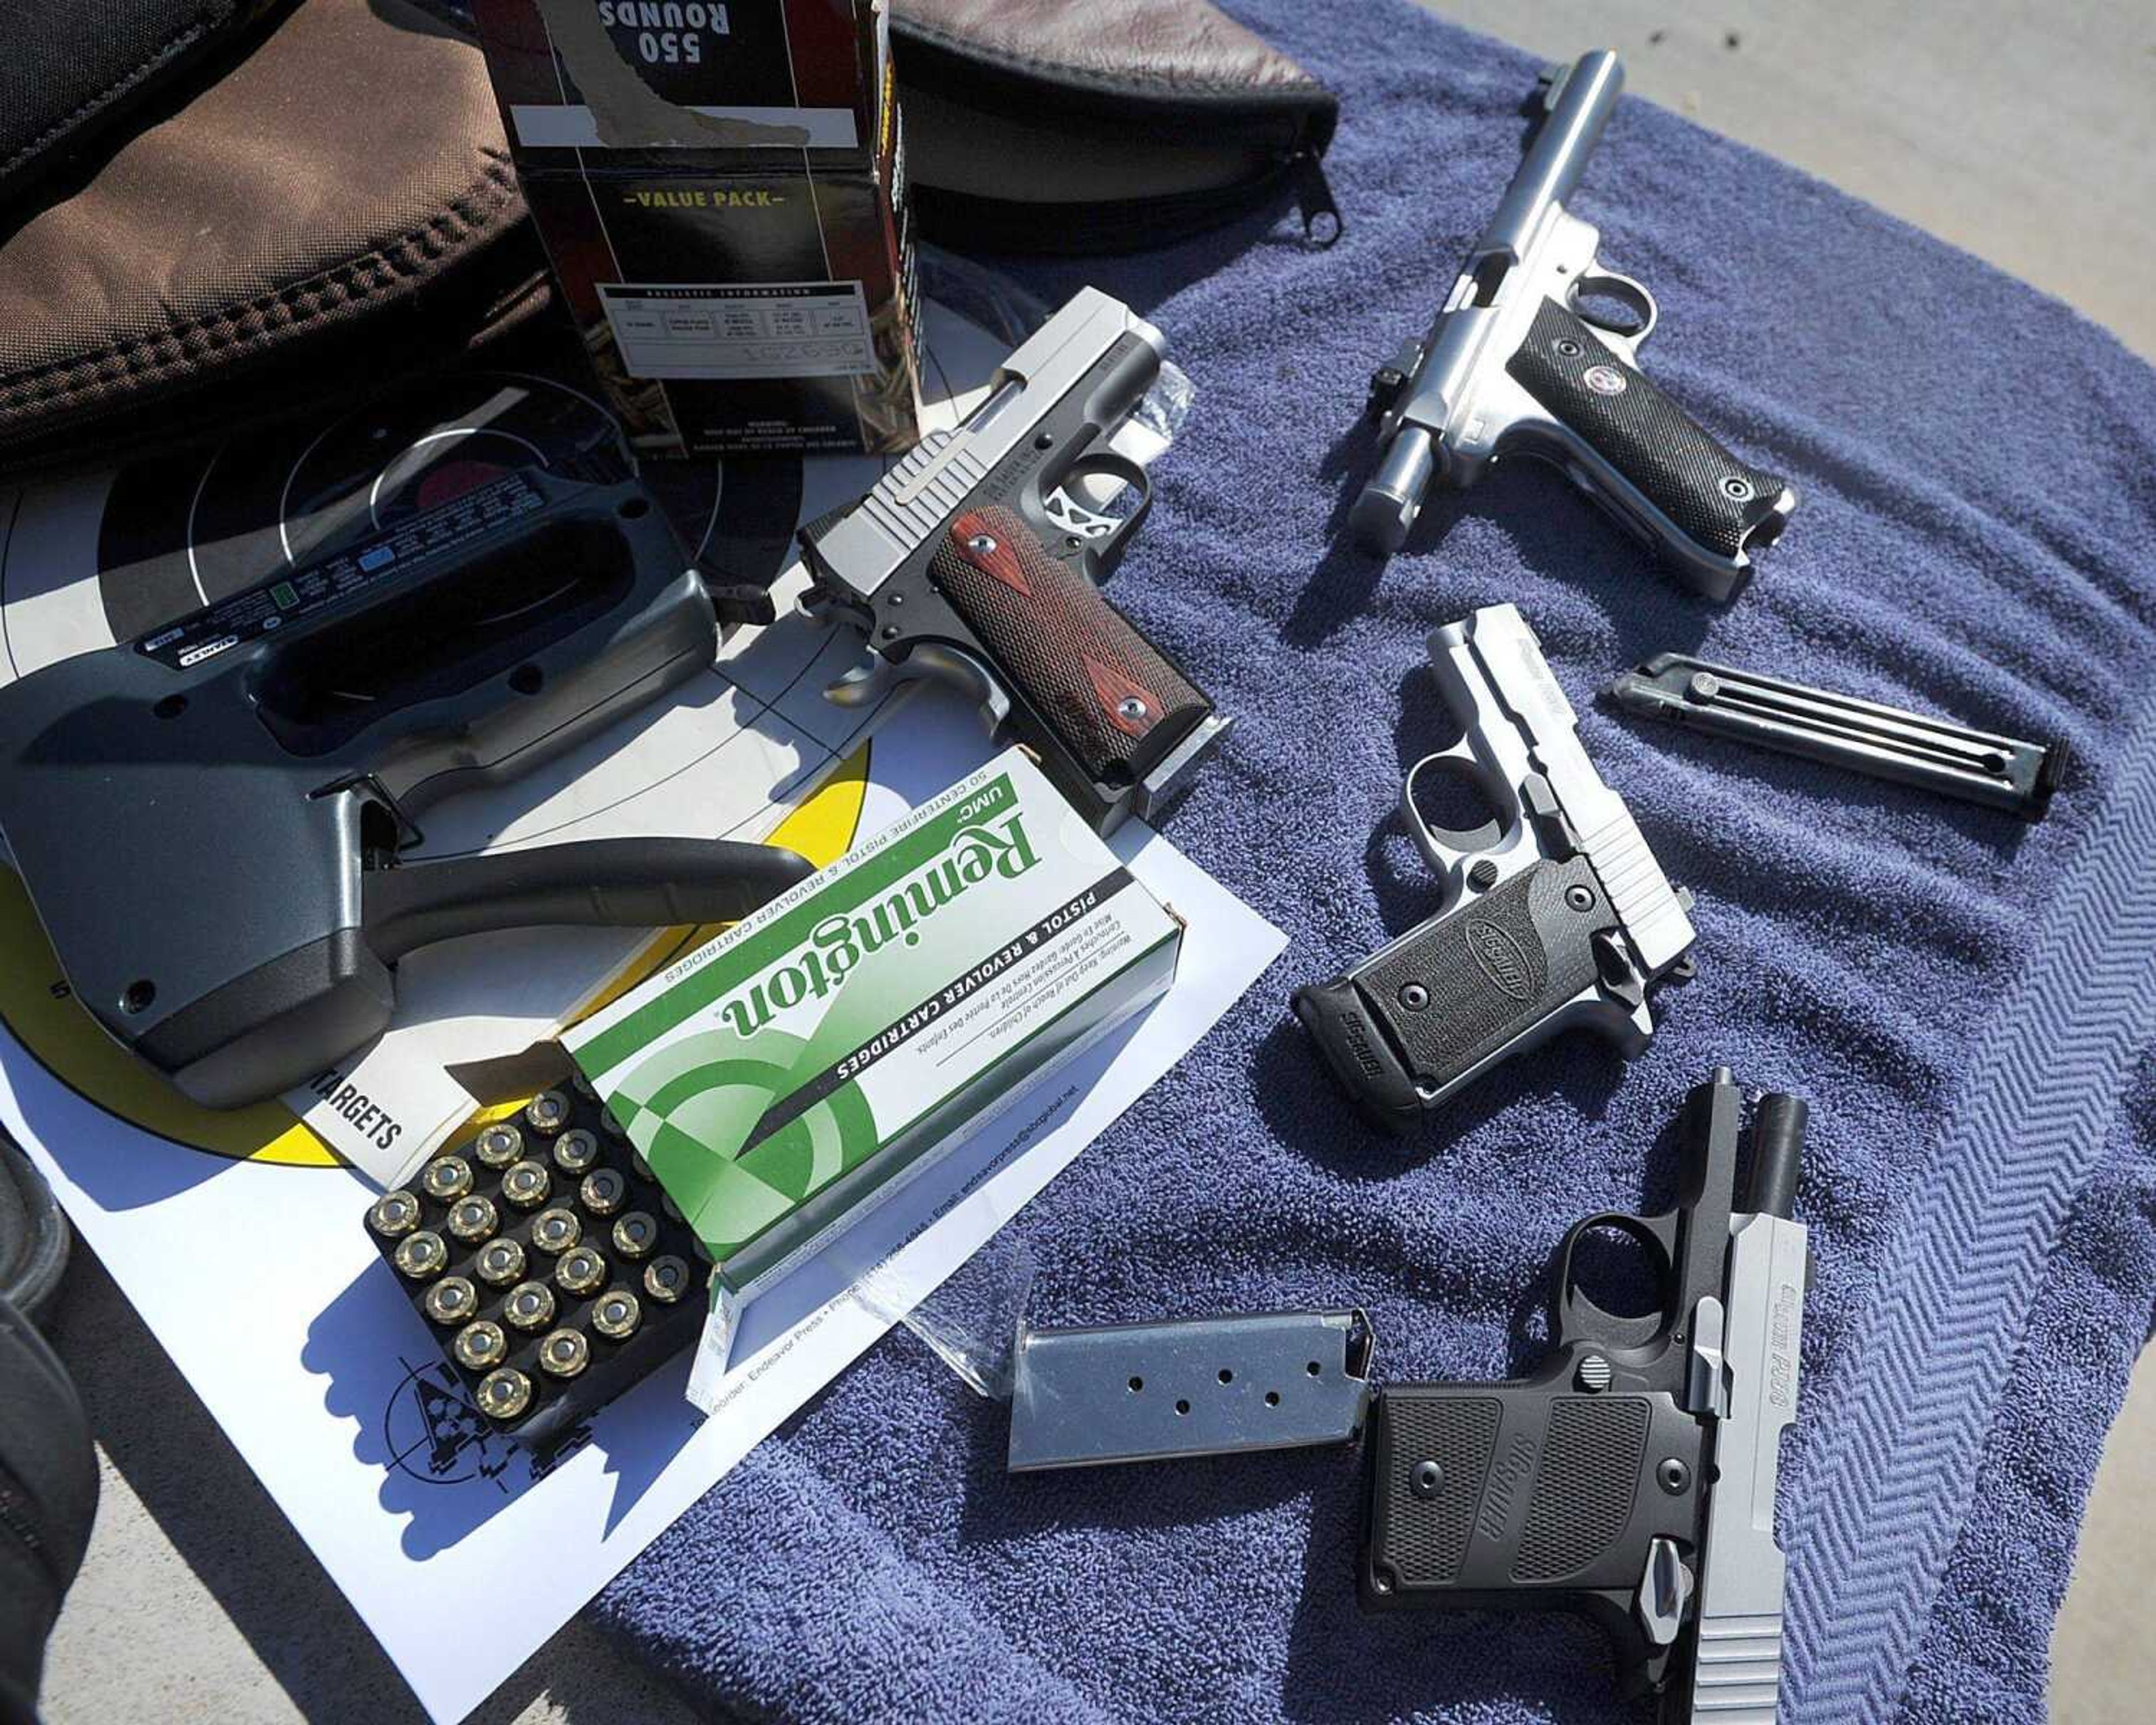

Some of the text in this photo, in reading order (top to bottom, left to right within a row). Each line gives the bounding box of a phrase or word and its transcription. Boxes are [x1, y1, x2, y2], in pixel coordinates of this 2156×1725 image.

[600, 1, 729, 35] ROUNDS
[640, 33, 700, 64] 550
[663, 769, 988, 983] 50 CENTERFIRE PISTOL & REVOLVER CARTRIDGES
[722, 812, 1042, 1033] Remington
[1080, 919, 1122, 953] Cartouches
[1030, 950, 1059, 974] Gardez
[1031, 953, 1075, 988] Percussion
[1077, 957, 1098, 976] Keep
[833, 891, 1097, 1080] PISTOL & REVOLVER CARTRIDGES
[1000, 982, 1013, 995] De
[1011, 969, 1032, 987] Hors
[1062, 970, 1079, 987] Out
[989, 990, 1002, 1003] La
[999, 982, 1034, 1010] Centrale
[1031, 987, 1057, 1009] Reach
[947, 1016, 965, 1032] Des
[310, 1069, 402, 1150] TARGETS
[748, 1340, 794, 1380] Endeavor
[794, 1317, 824, 1340] Press
